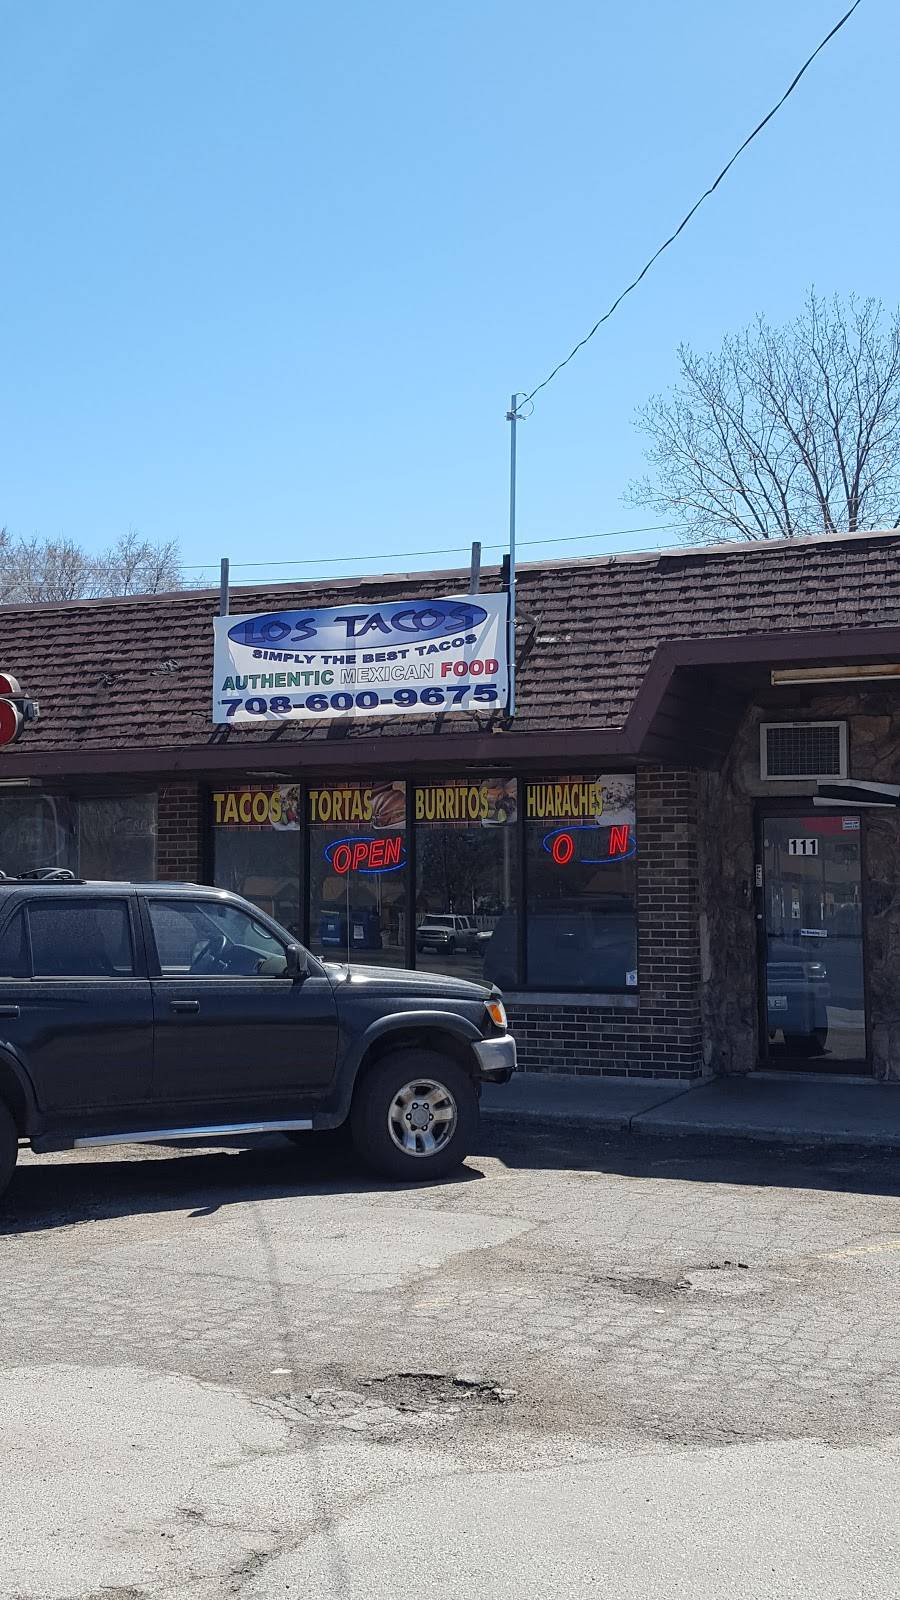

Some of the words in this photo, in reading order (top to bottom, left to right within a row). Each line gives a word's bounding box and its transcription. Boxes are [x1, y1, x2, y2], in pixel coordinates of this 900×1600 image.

[244, 617, 318, 643] LOS
[333, 605, 474, 637] TACOS
[252, 649, 316, 665] SIMPLY
[321, 654, 357, 665] THE
[362, 649, 410, 663] BEST
[415, 633, 478, 656] TACOS
[221, 669, 335, 691] AUTHENTIC
[340, 662, 434, 684] MEXICAN
[440, 658, 499, 678] FOOD
[221, 683, 498, 717] 708-600-9675
[213, 791, 282, 823] TACOS
[309, 789, 373, 822] TORTAS
[415, 786, 489, 820] BURRITOS
[527, 783, 603, 817] HUARACHES
[333, 837, 401, 874] OPEN
[791, 839, 816, 855] 111
